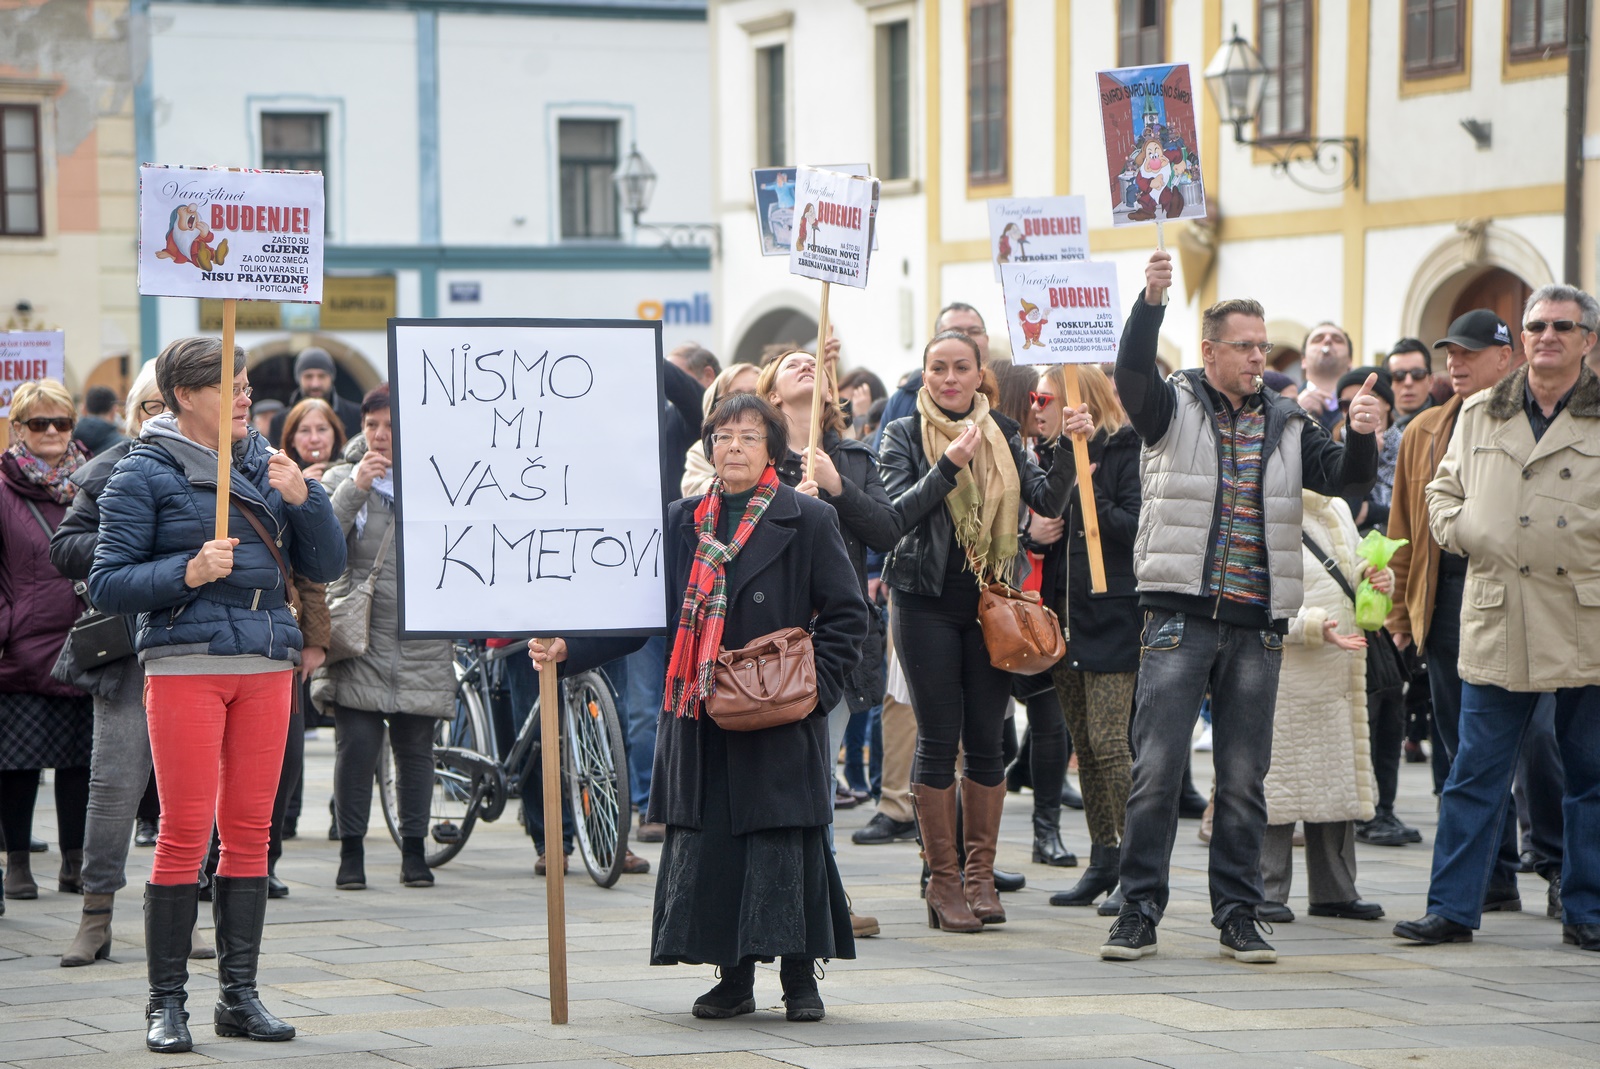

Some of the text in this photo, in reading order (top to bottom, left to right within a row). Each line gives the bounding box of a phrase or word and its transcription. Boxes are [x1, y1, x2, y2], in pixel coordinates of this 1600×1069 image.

[162, 180, 246, 207] Varaždinci
[802, 180, 836, 201] Varaždinci
[210, 203, 310, 233] BUĐENJE!
[818, 201, 862, 231] BUĐENJE!
[262, 244, 309, 254] CIJENE
[272, 235, 309, 245] ZAŠTO SU
[254, 255, 280, 263] ODVOZ
[282, 255, 309, 264] SMEĆA
[807, 243, 860, 260] POTROŠENI NOVCI
[1015, 253, 1057, 262] POTROŠENI
[202, 272, 309, 284] NISU PRAVEDNE
[240, 265, 267, 273] TOLIKO
[269, 266, 304, 274] NARASLE
[798, 258, 859, 278] ZBRINJAVANJE BALA?
[1015, 270, 1069, 290] Varaždinci
[1049, 287, 1111, 308] BUĐENJE!
[1056, 321, 1114, 329] POSKUPLJUJE
[491, 407, 543, 449] MI
[429, 455, 569, 507] VAŠI
[436, 523, 662, 590] KMETOVI
